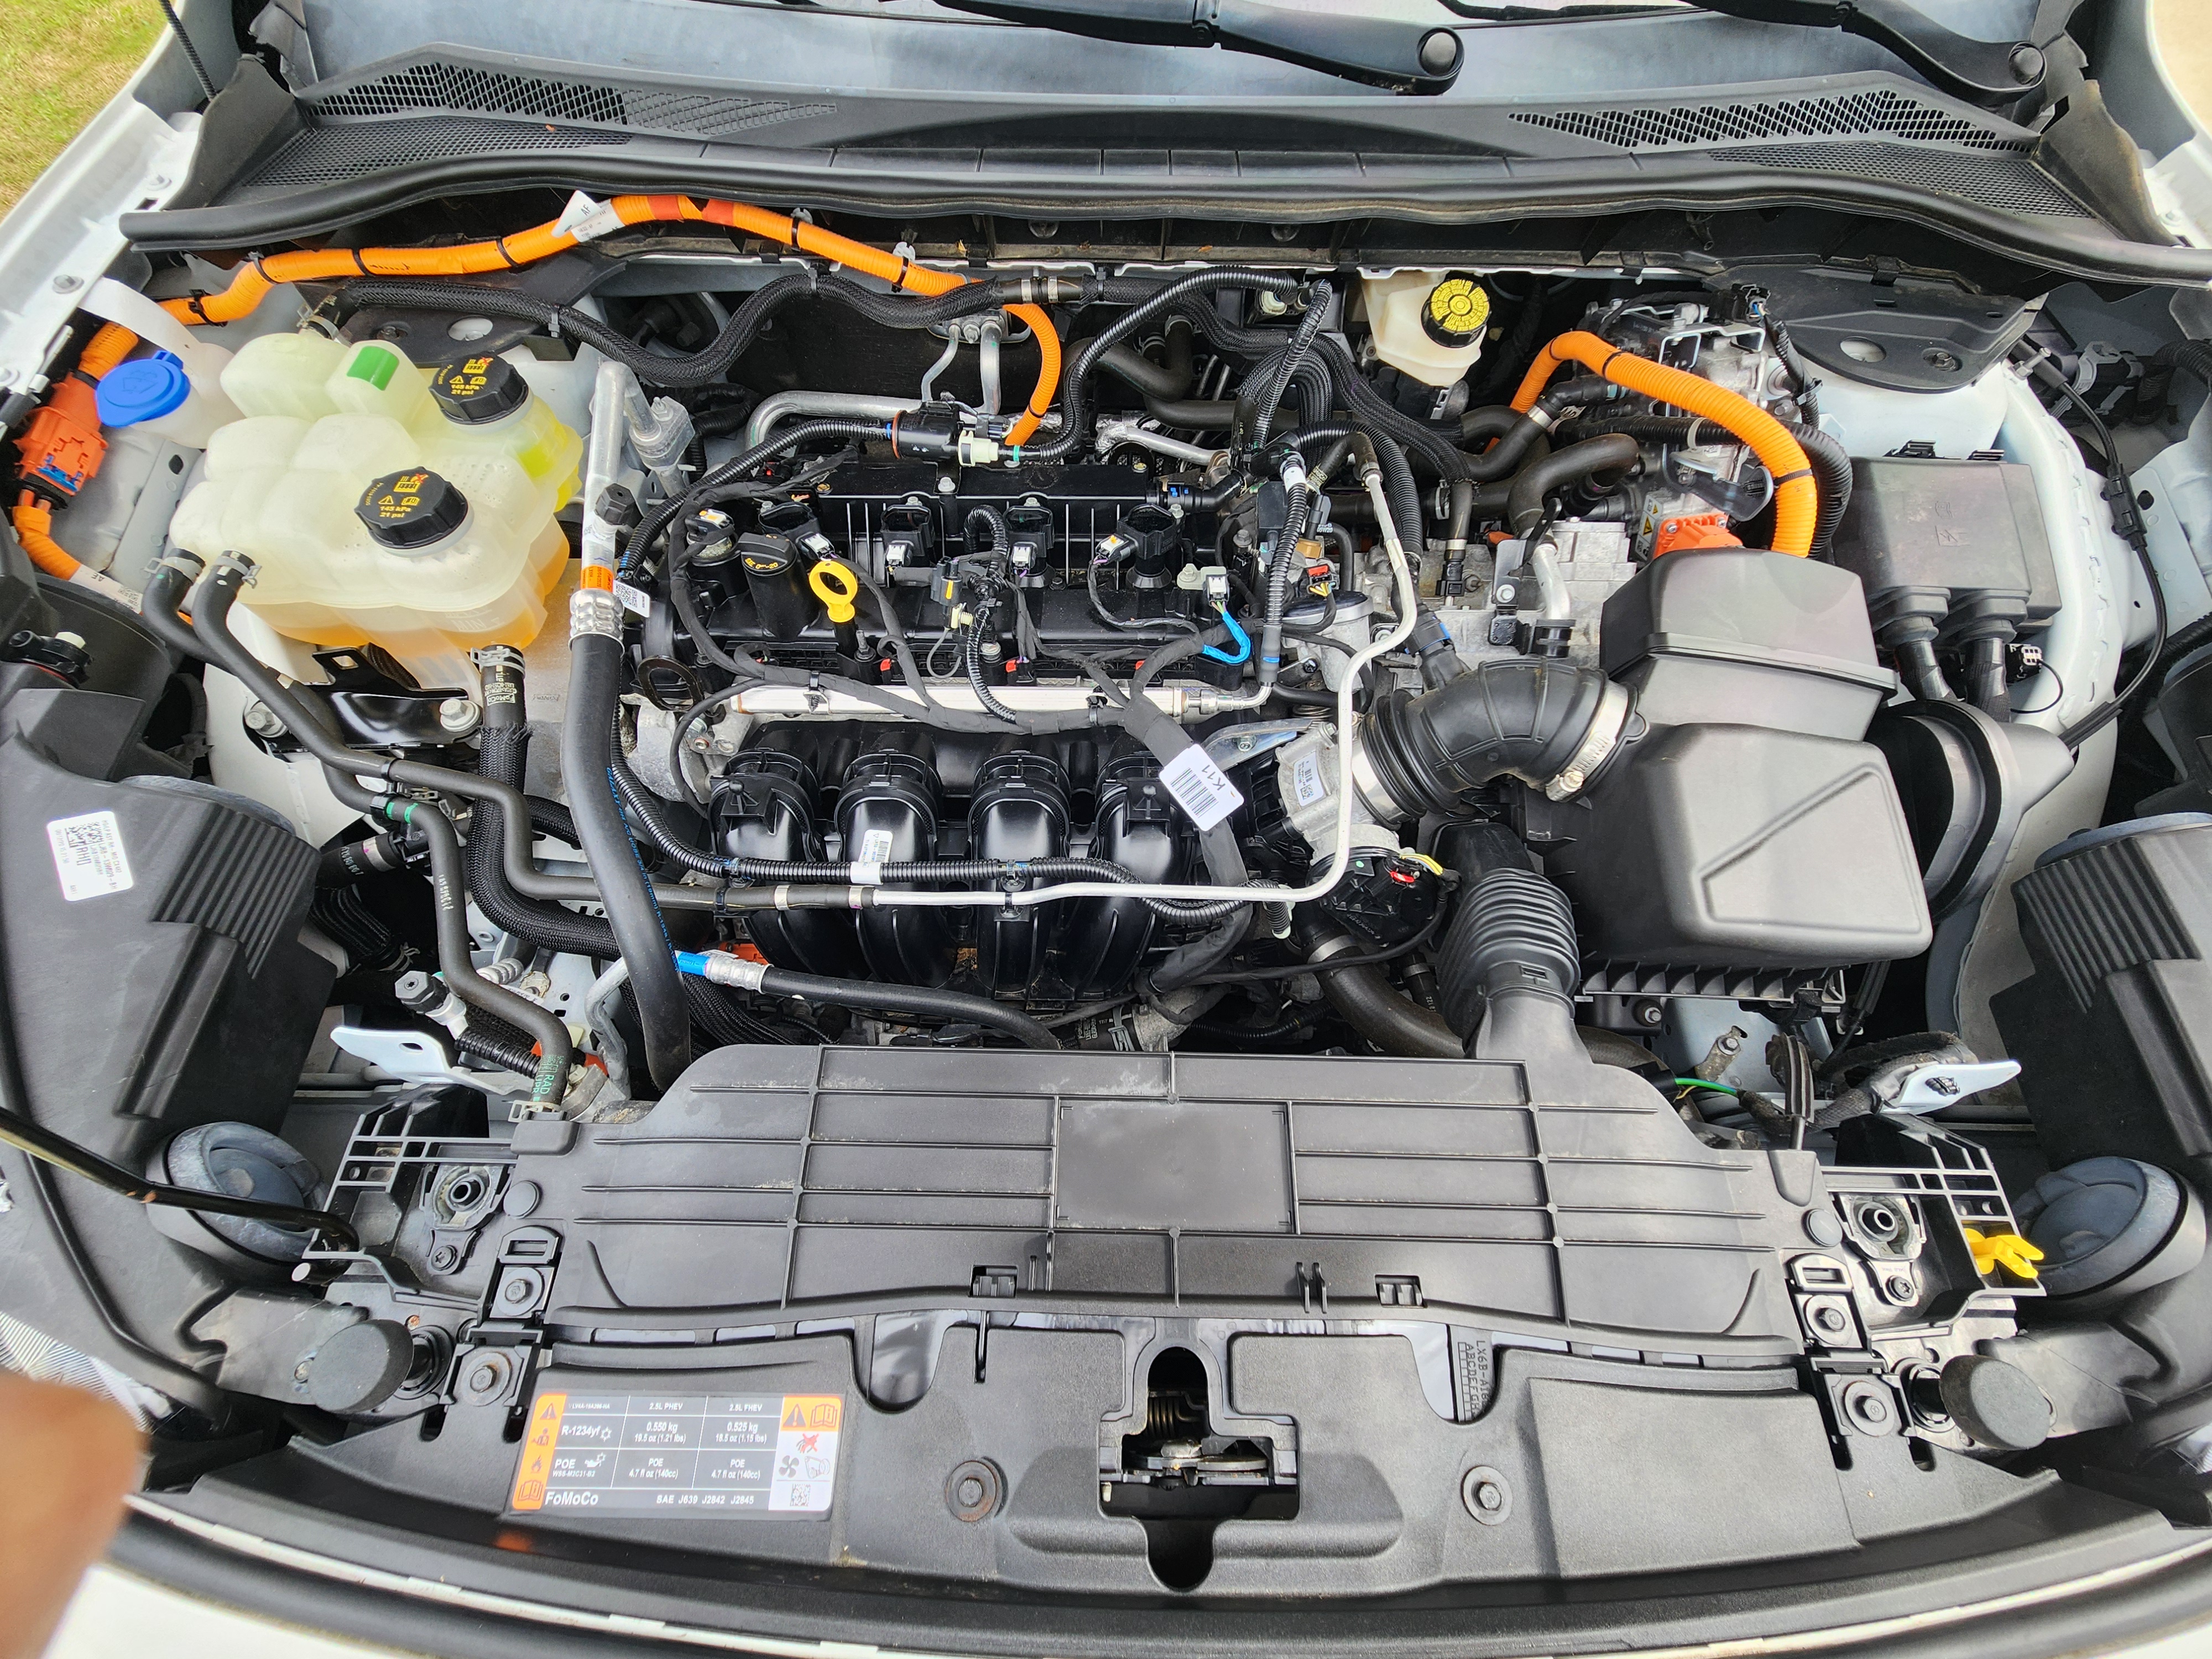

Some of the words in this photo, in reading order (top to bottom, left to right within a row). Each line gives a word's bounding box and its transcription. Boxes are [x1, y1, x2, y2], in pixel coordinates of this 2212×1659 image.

[581, 205, 591, 216] AF
[91, 572, 105, 582] AE
[1201, 765, 1226, 791] K11
[531, 1074, 543, 1094] UPR
[540, 1074, 555, 1094] RAD
[561, 1425, 601, 1437] R-1234yf
[646, 1421, 667, 1432] 0.550
[668, 1421, 678, 1433] kg
[727, 1422, 748, 1432] 0.525
[748, 1422, 758, 1434] kg
[634, 1434, 648, 1443] 19.5
[657, 1434, 672, 1444] (1.21
[674, 1434, 686, 1444] lbs)
[715, 1434, 728, 1443] 18.5
[738, 1434, 754, 1444] (1.15
[755, 1434, 768, 1444] lbs)
[554, 1459, 576, 1469] POE
[648, 1458, 664, 1467] POE
[730, 1459, 745, 1468] POE
[655, 1469, 679, 1479] (140cc)
[711, 1469, 722, 1478] 4.7
[723, 1469, 728, 1478] fl
[737, 1469, 761, 1480] (140cc)
[545, 1491, 599, 1506] FoMoCo
[656, 1495, 674, 1504] SAE
[678, 1495, 698, 1504] J639
[702, 1495, 726, 1505] J2842
[730, 1495, 754, 1505] J2845
